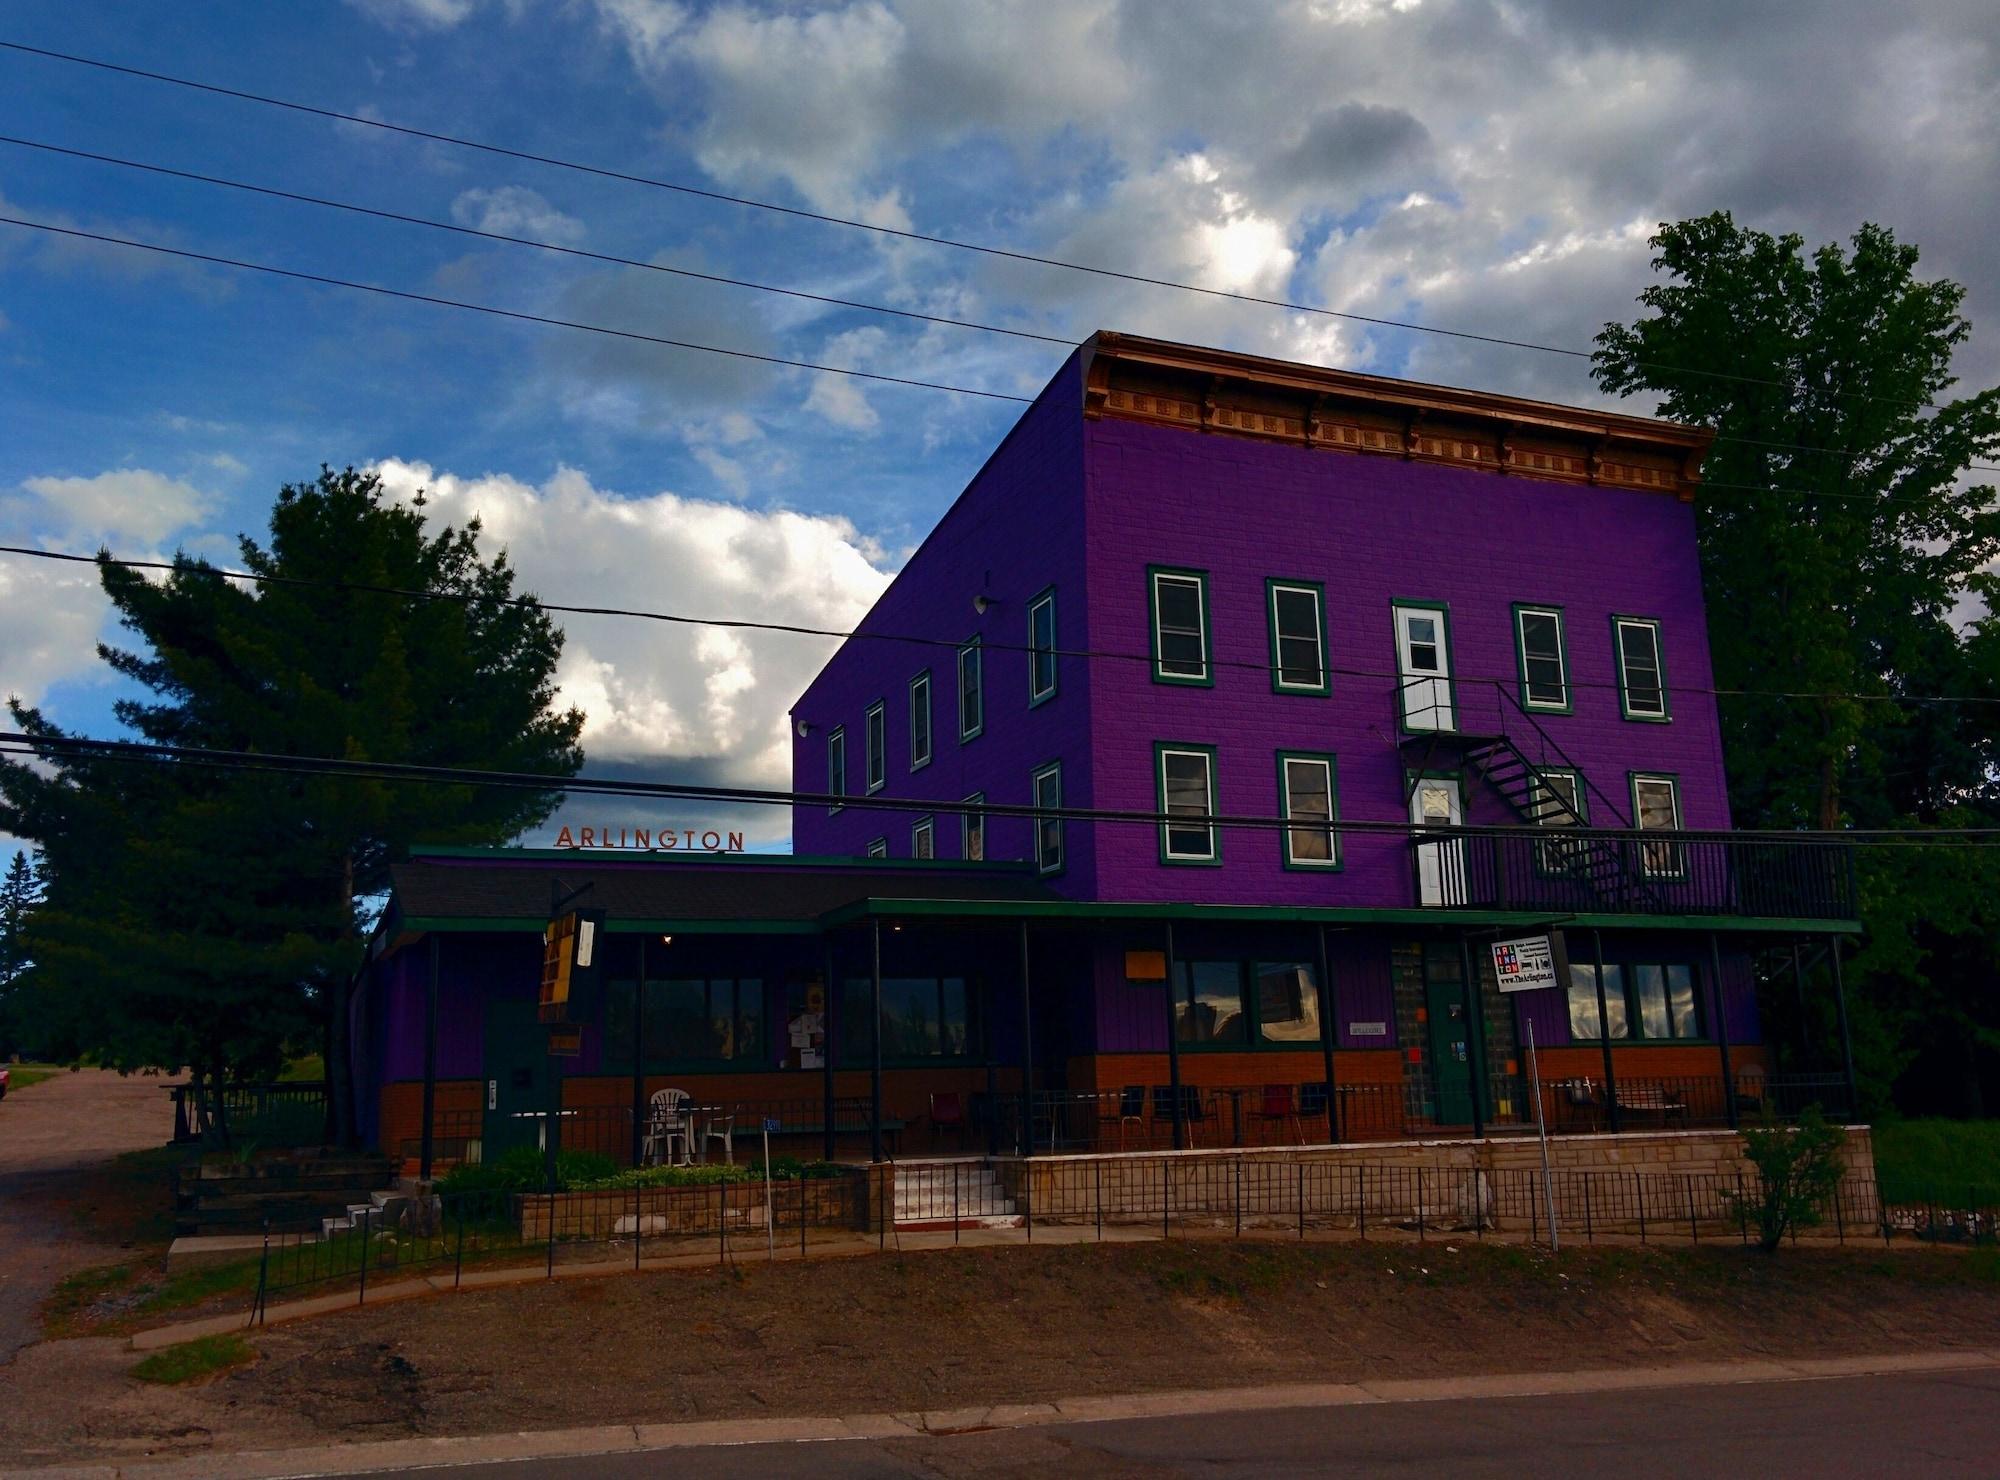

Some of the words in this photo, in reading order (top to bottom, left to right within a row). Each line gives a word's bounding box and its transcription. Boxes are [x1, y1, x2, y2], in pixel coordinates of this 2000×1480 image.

[556, 826, 743, 850] ARLINGTON
[1496, 946, 1514, 955] ARL
[1500, 965, 1518, 973] TON
